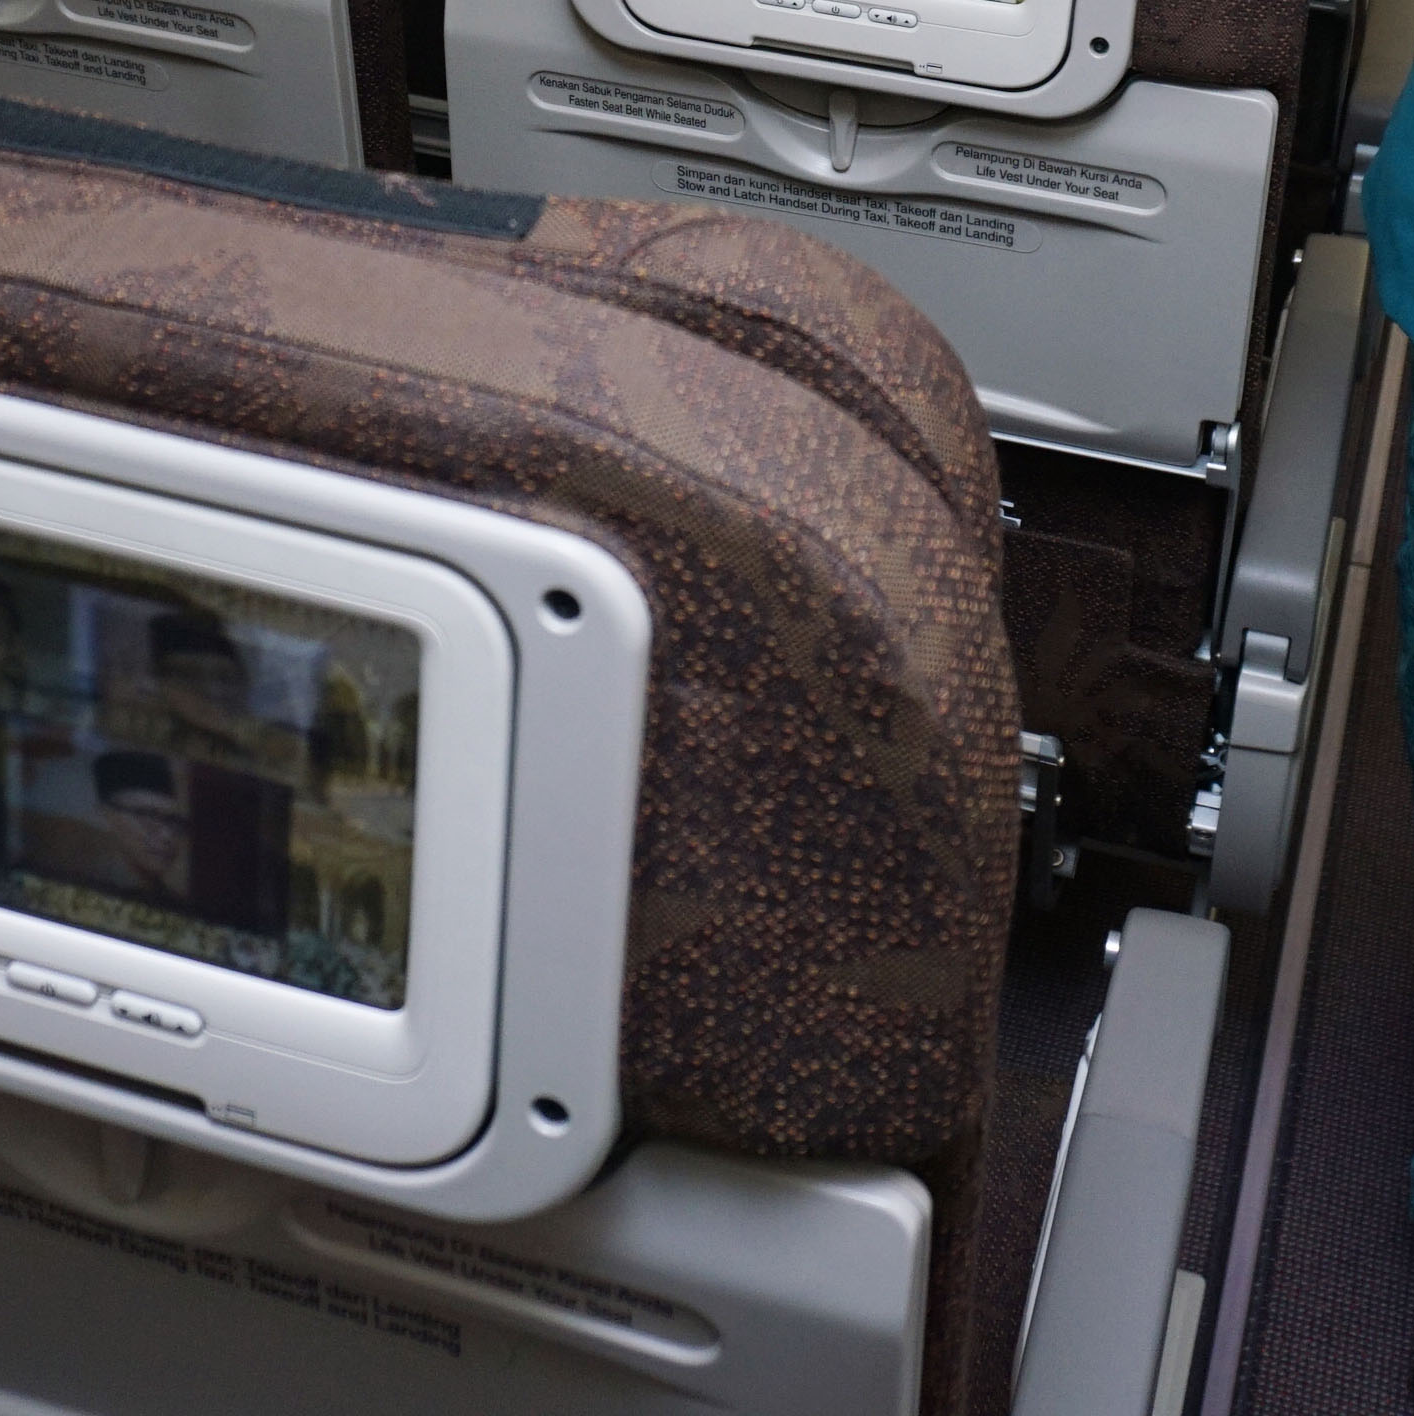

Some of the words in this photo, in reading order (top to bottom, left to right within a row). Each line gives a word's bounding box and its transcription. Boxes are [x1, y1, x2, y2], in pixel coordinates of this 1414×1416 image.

[97, 7, 114, 18] Life
[117, 10, 138, 22] Vest
[140, 15, 169, 28] Under
[172, 20, 194, 32] Your
[196, 25, 218, 39] Seat
[134, 0, 144, 9] Di
[147, 2, 179, 17] Bawah
[182, 8, 207, 22] Kursi
[209, 13, 235, 27] Anda
[42, 43, 79, 58] Takeoff
[81, 51, 101, 63] dan
[103, 55, 145, 73] Landing
[44, 55, 80, 70] Takeoff
[83, 64, 103, 75] and
[105, 67, 146, 86] Landing
[539, 76, 580, 92] Kenakan
[582, 83, 612, 98] Sabuk
[614, 88, 664, 105] Pengaman
[666, 97, 702, 113] Selama
[704, 103, 735, 120] Duduk
[569, 95, 600, 109] Fasten
[602, 100, 624, 114] Seat
[625, 104, 643, 117] Belt
[646, 108, 672, 122] While
[674, 113, 707, 129] Seated
[955, 146, 1020, 169] Pelampung
[1023, 157, 1035, 169] Di
[1038, 161, 1077, 177] Bawah
[1080, 168, 1109, 183] Kursi
[1112, 175, 1143, 190] Anda
[976, 165, 996, 179] Life
[999, 169, 1023, 183] Vest
[1026, 174, 1061, 190] Under
[1064, 181, 1089, 195] Your
[1093, 186, 1120, 201] Seat
[677, 165, 721, 183] Simpan
[724, 175, 746, 187] dan
[749, 178, 780, 193] kunci
[783, 183, 832, 201] Handset
[836, 195, 861, 206] saat
[866, 197, 890, 212] Taxi,
[894, 202, 937, 219] Takeoff
[940, 210, 963, 223] dan
[966, 214, 1015, 234] Landing
[677, 178, 705, 193] Stow
[708, 184, 731, 197] and
[734, 189, 765, 203] Latch
[769, 194, 818, 211] Handset
[821, 203, 860, 221] During
[864, 209, 890, 225] Taxi,
[892, 214, 936, 231] Takeoff
[939, 223, 962, 236] and
[965, 227, 1014, 247] Landing
